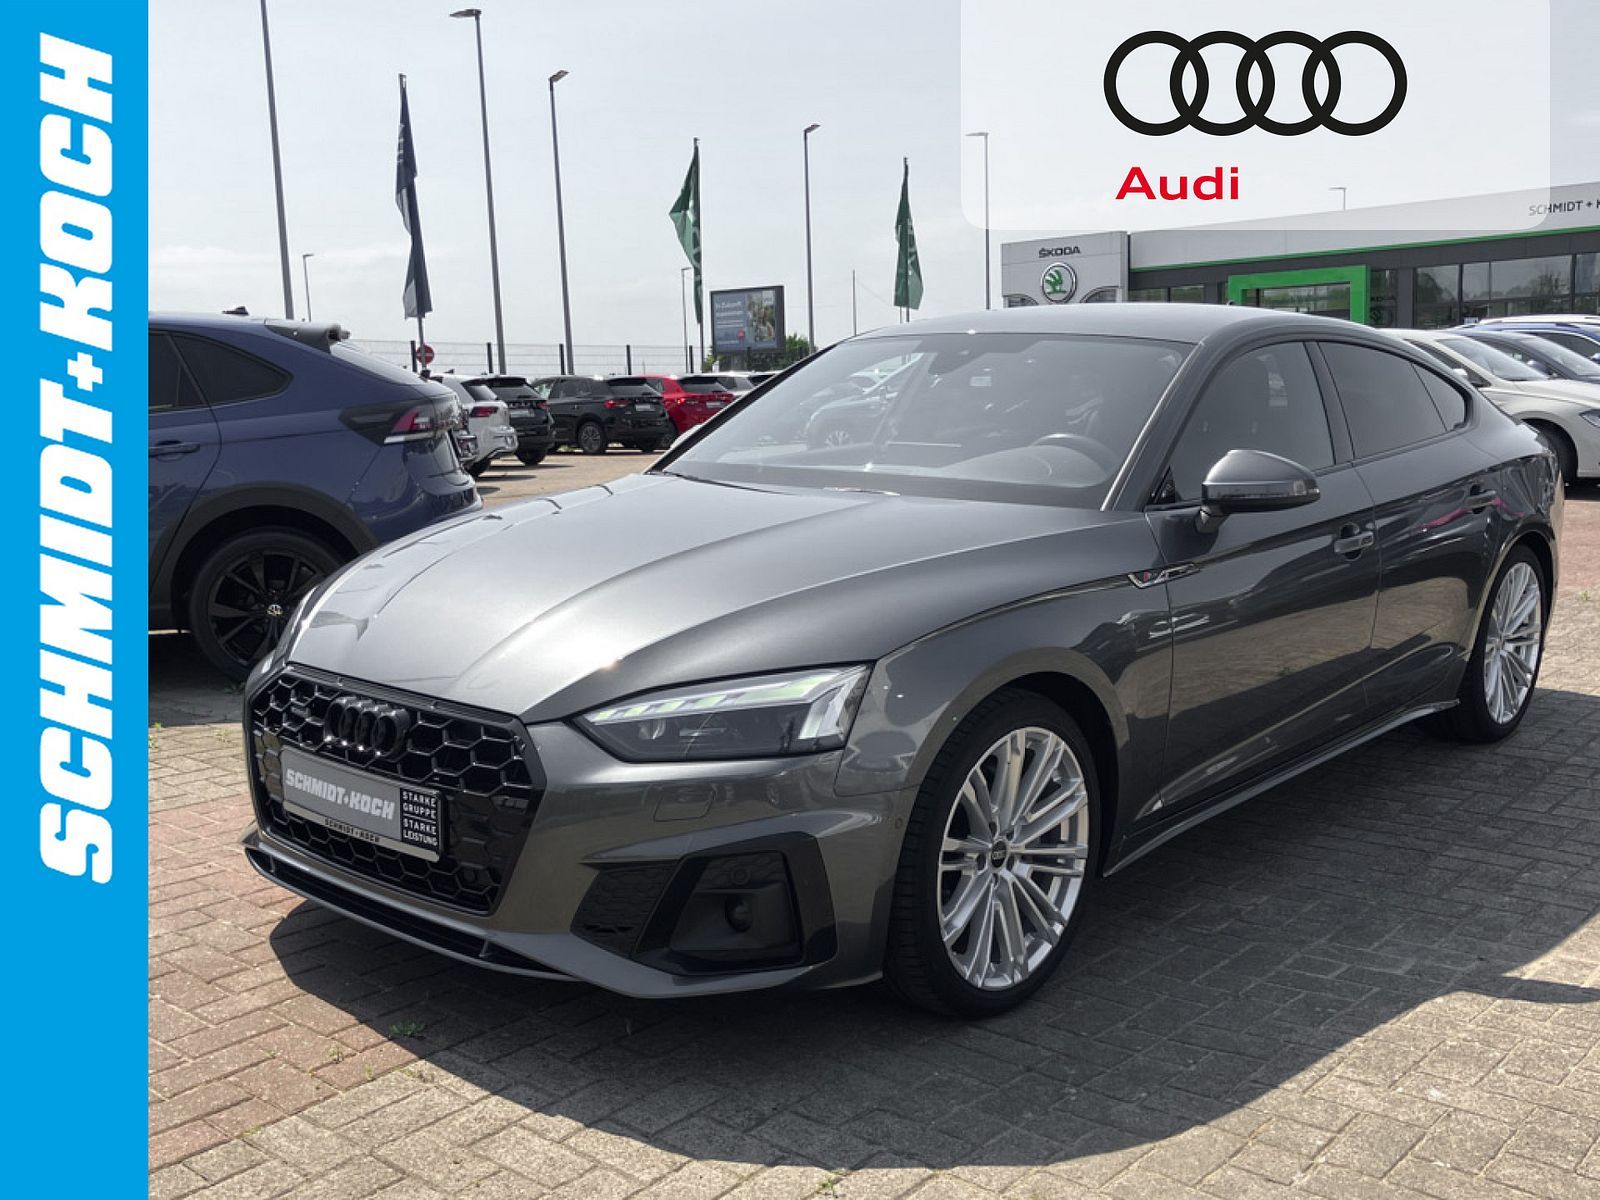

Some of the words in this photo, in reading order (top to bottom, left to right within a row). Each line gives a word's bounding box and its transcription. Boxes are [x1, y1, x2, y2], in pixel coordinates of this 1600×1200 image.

[1528, 200, 1583, 216] SCHMIDT
[1038, 246, 1081, 258] ŠKODA
[402, 790, 437, 807] STARKE
[402, 802, 437, 820] GRUPPE
[402, 818, 437, 835] STARKE
[402, 829, 438, 847] LEISTUNG
